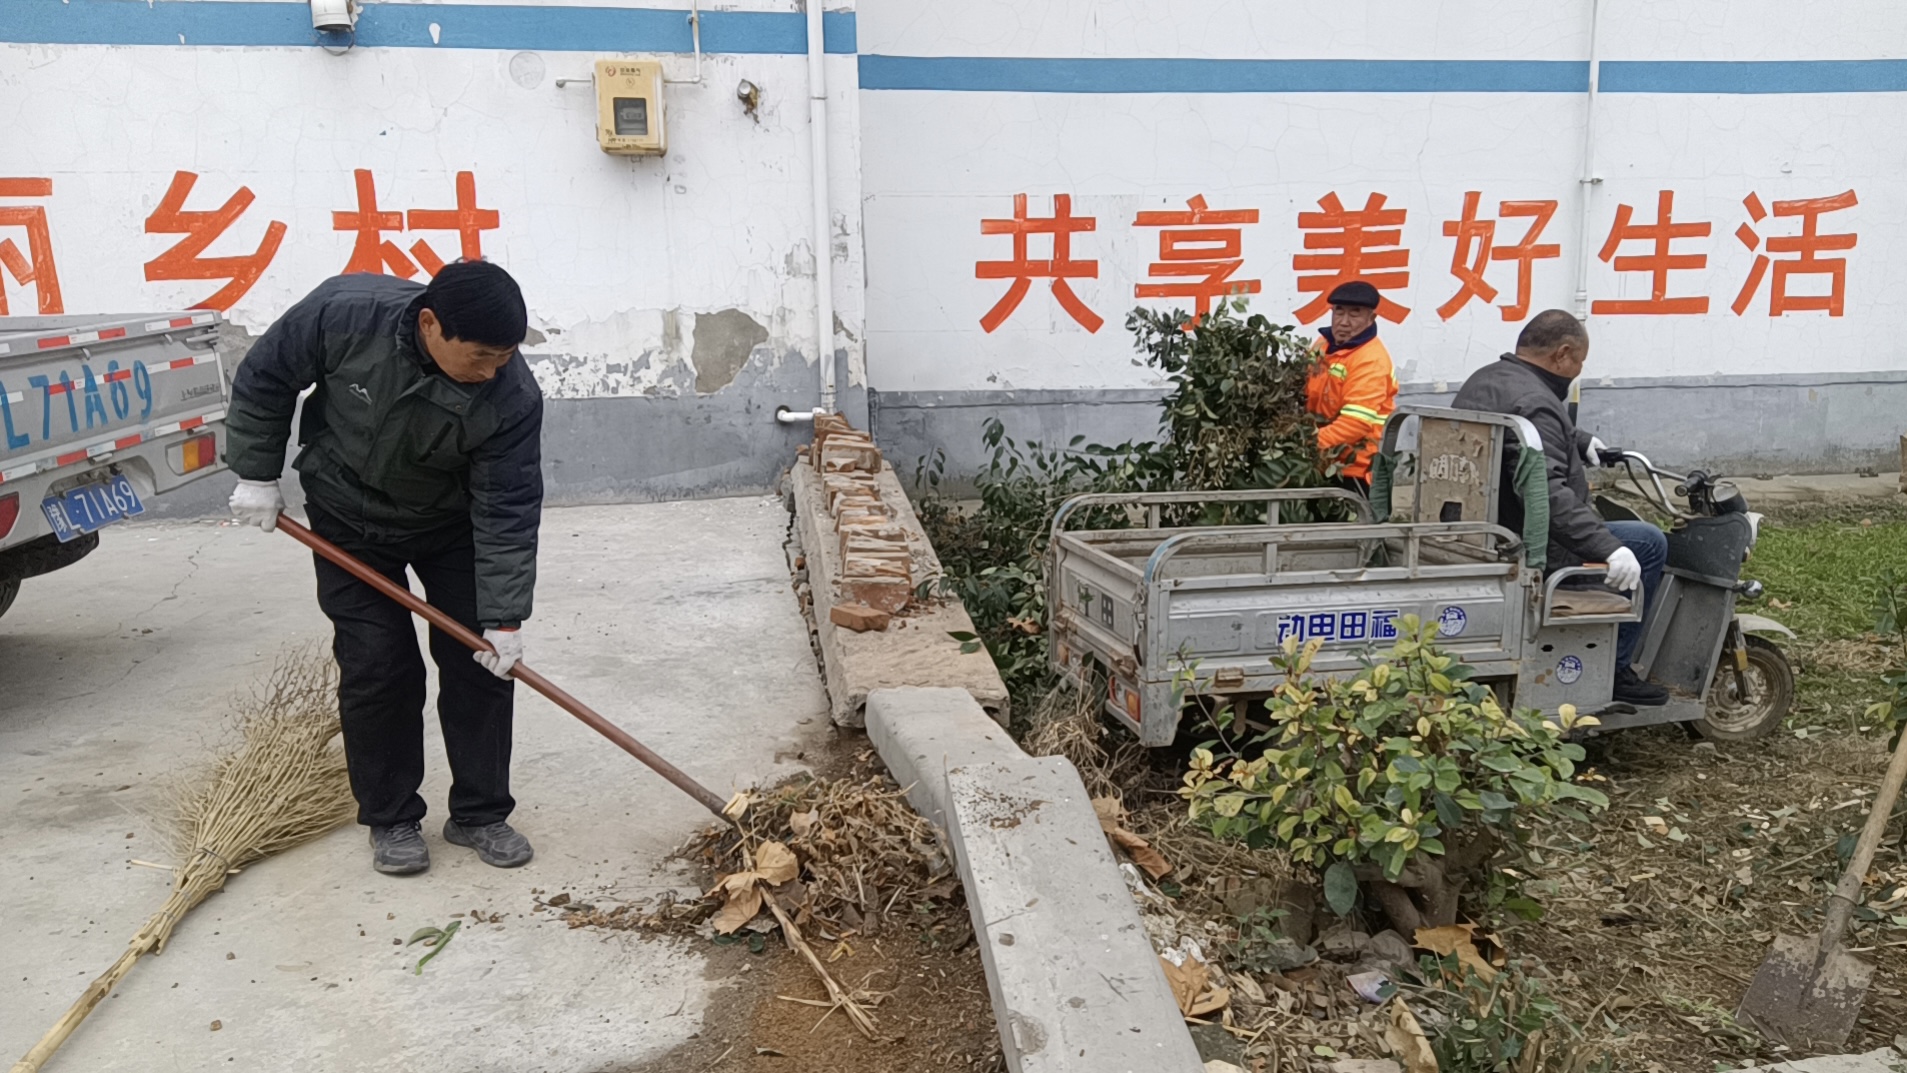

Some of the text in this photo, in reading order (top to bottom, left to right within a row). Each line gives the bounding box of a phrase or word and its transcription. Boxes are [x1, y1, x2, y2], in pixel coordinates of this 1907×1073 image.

[975, 189, 1858, 333] 共享美好生活
